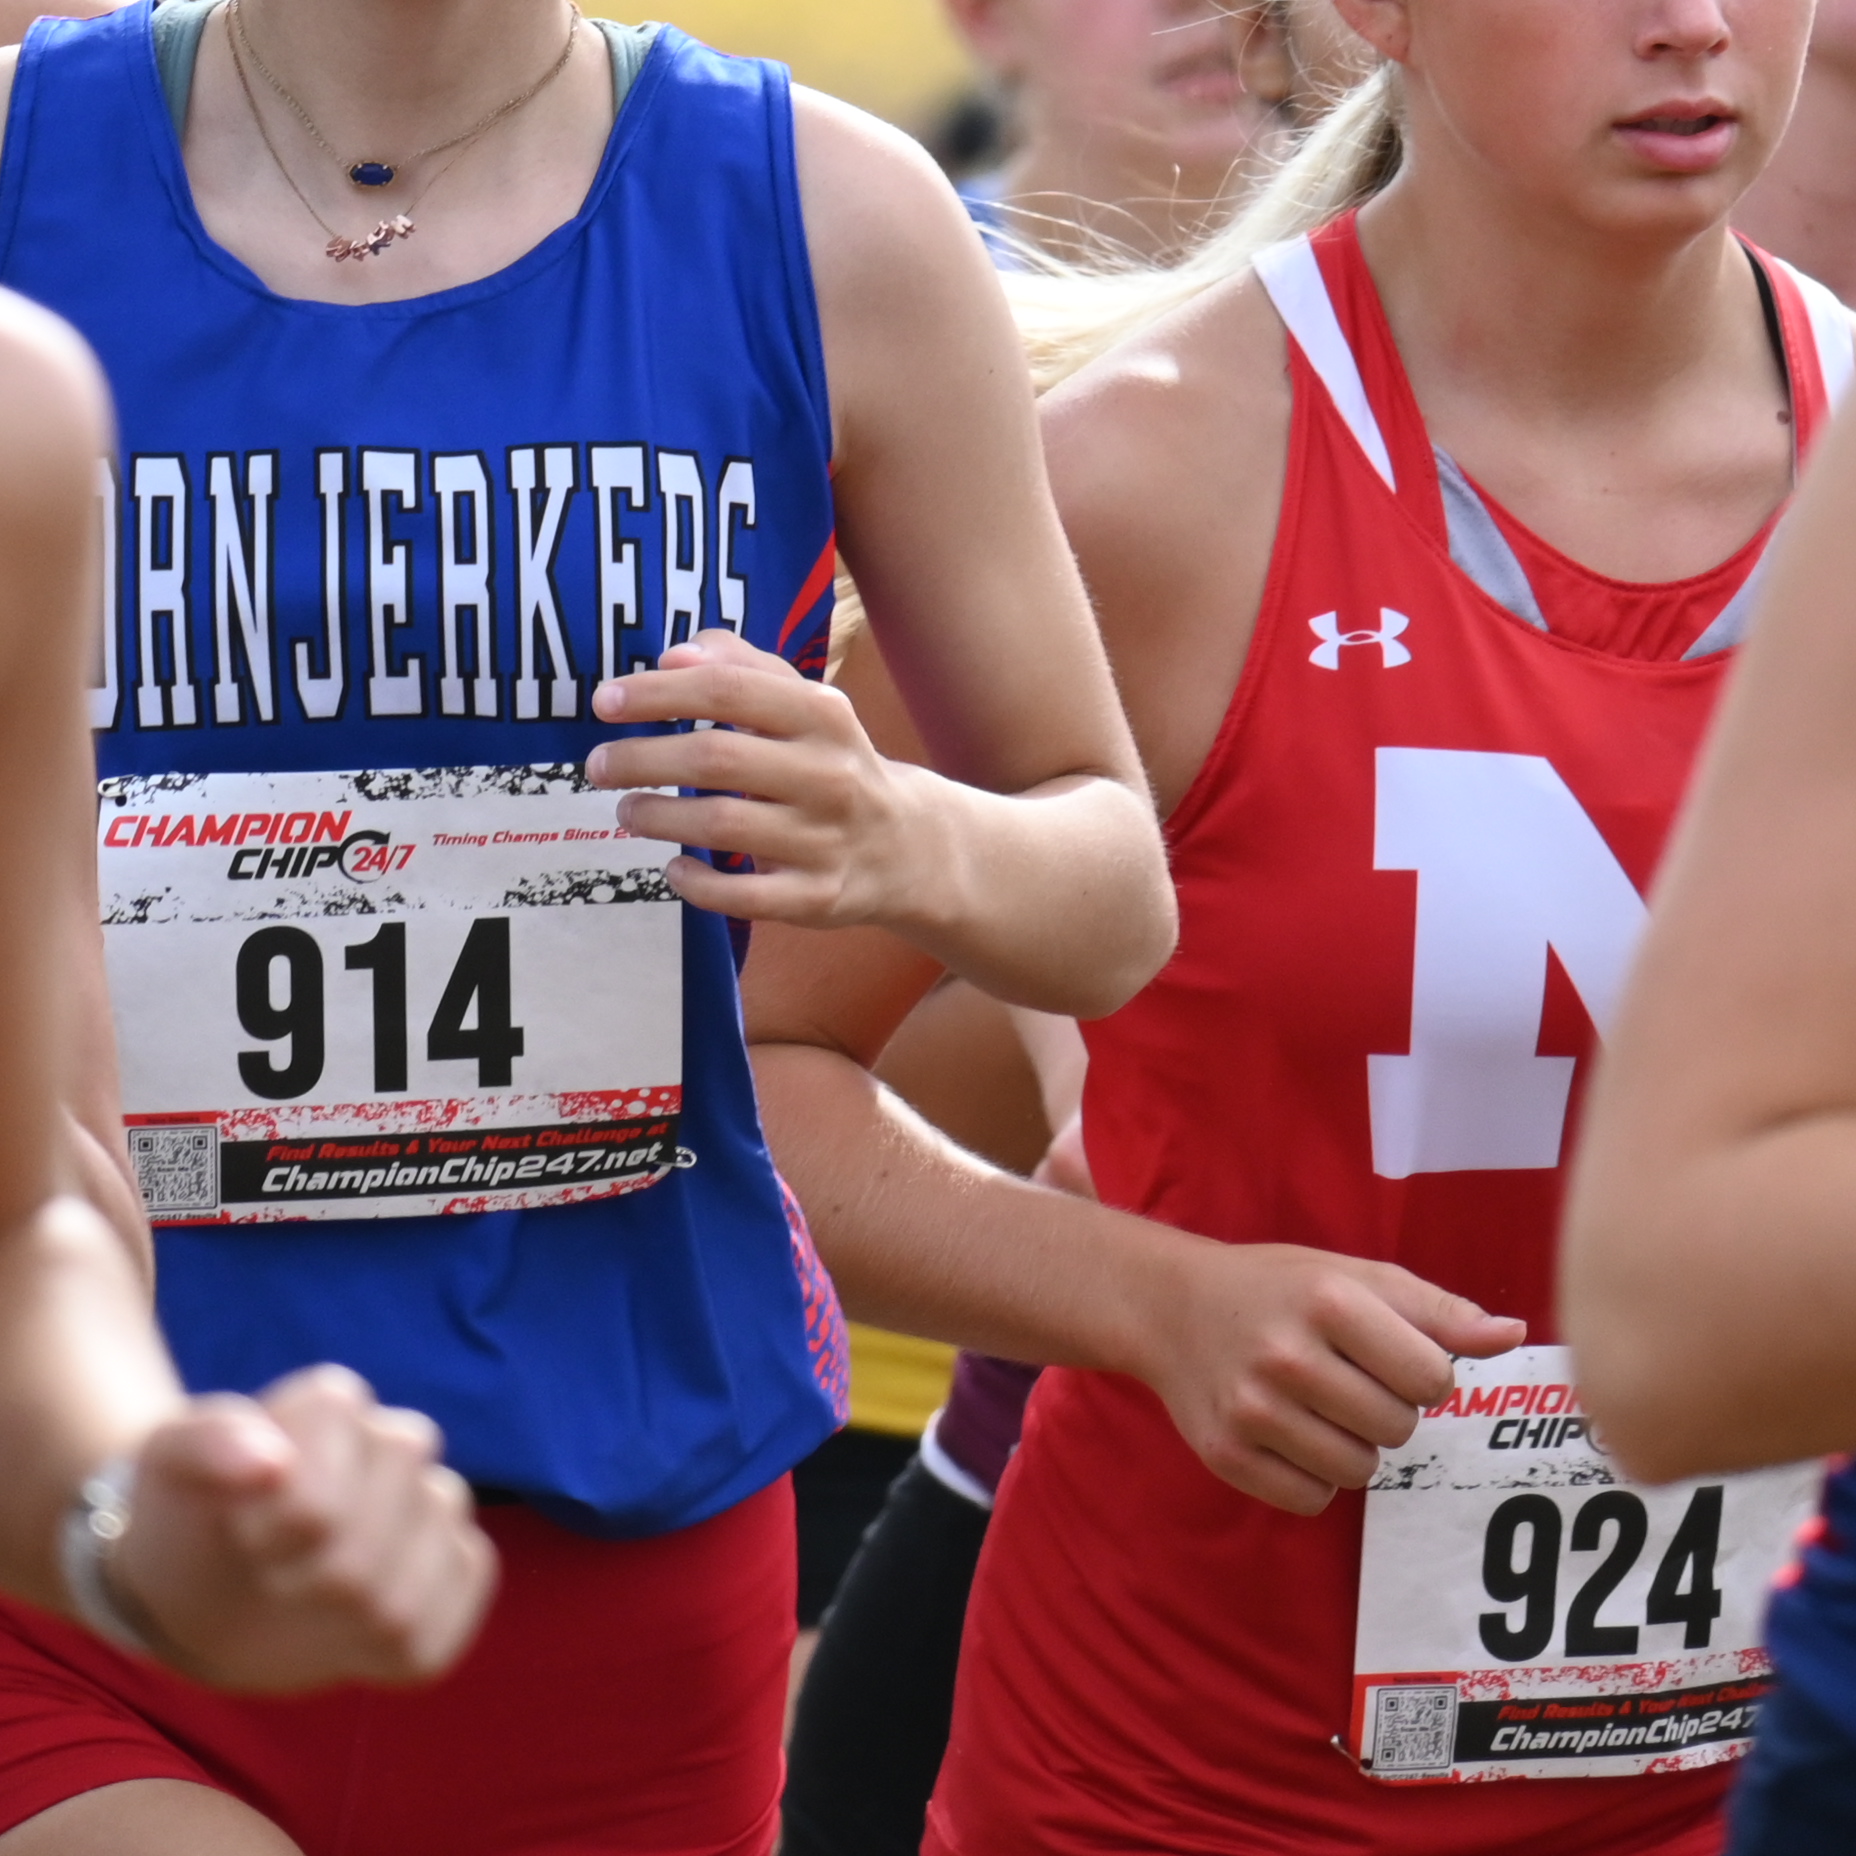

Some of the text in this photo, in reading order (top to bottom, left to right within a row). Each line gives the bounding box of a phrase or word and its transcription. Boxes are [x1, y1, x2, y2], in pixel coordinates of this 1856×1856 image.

[103, 810, 353, 848] CHAMPION
[432, 832, 489, 847] Timing
[493, 829, 560, 845] Champs
[563, 826, 610, 842] Since
[227, 844, 417, 880] CHIP 24/7
[236, 916, 525, 1101] 914
[265, 1144, 317, 1163] Find
[317, 1140, 401, 1160] Results
[428, 1136, 479, 1155] Your
[481, 1134, 533, 1152] Next
[536, 1127, 643, 1148] Challenge
[646, 1122, 670, 1137] at
[261, 1141, 664, 1194] ChampionChip247.net
[1488, 1416, 1587, 1450] CHIP
[1478, 1484, 1724, 1663] 924
